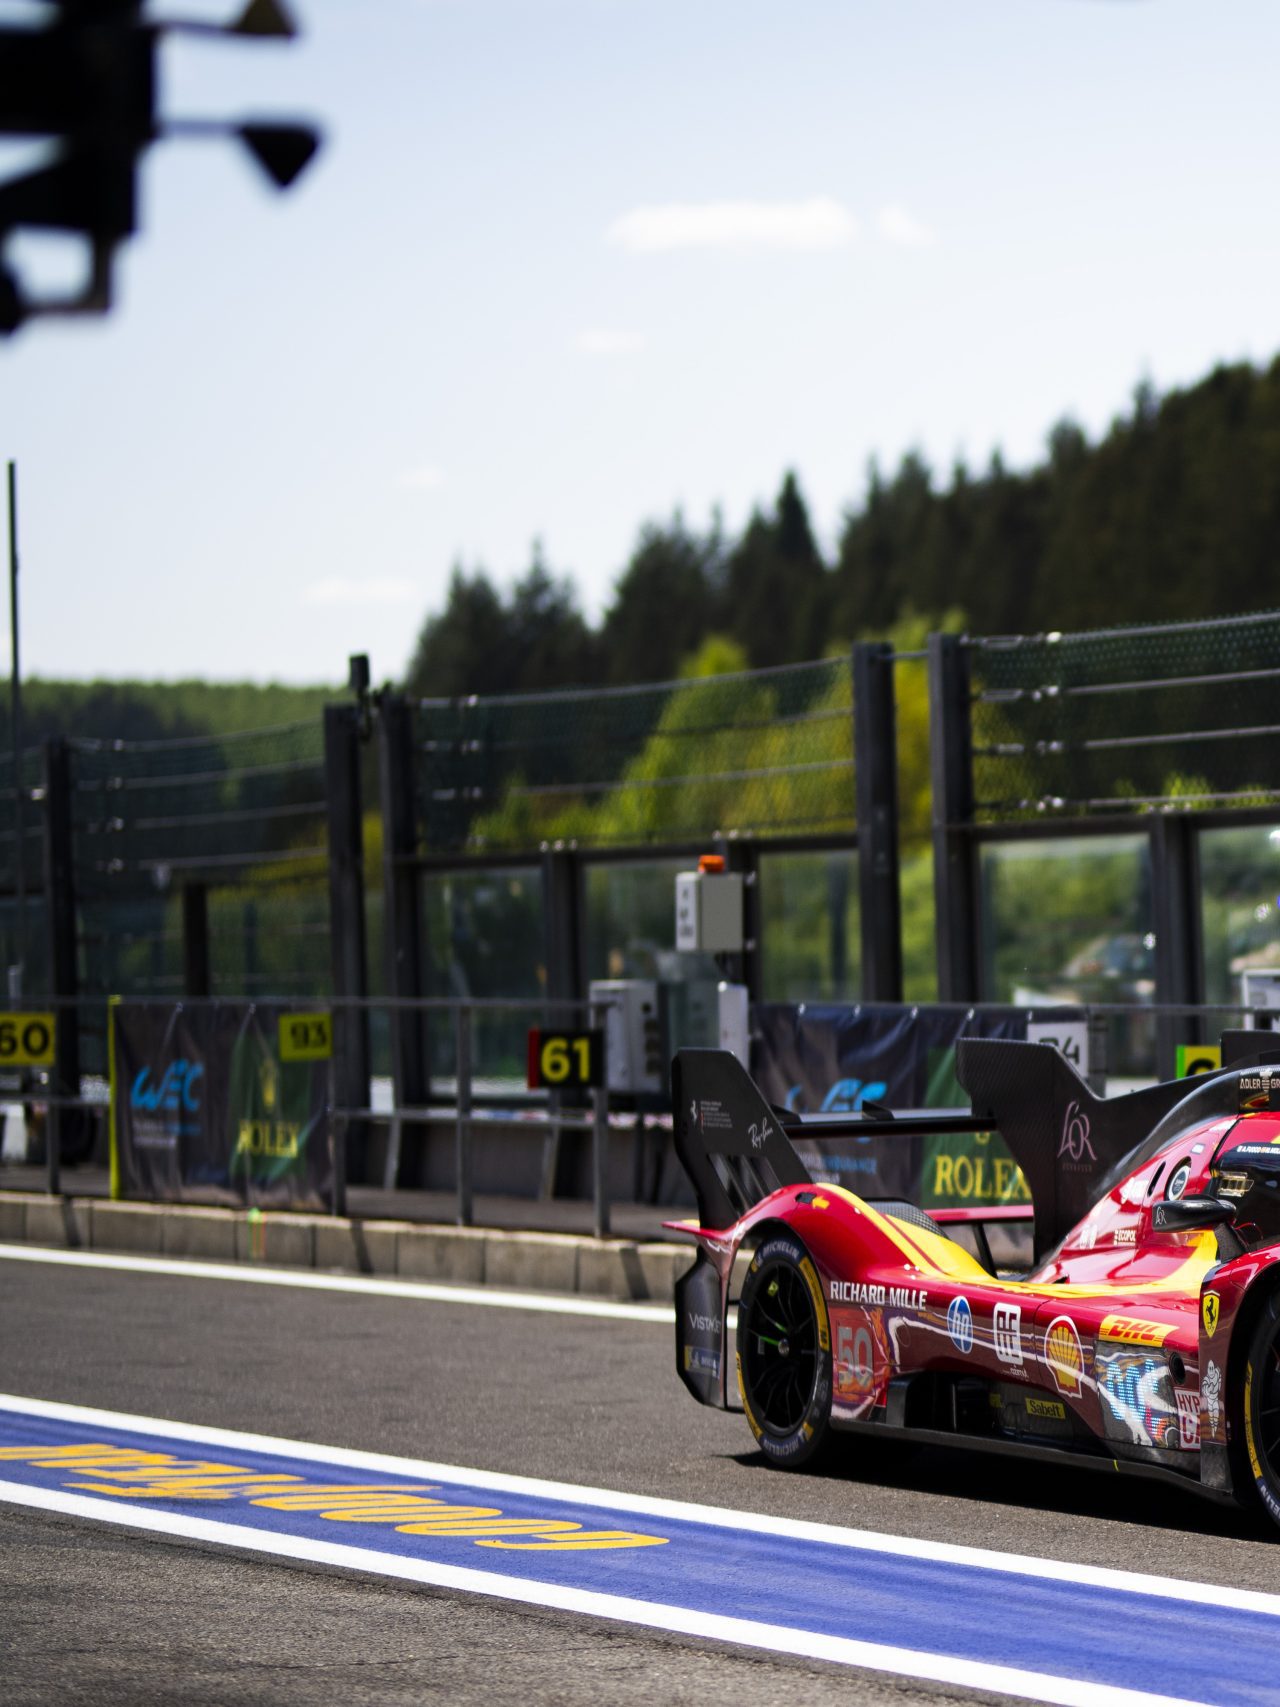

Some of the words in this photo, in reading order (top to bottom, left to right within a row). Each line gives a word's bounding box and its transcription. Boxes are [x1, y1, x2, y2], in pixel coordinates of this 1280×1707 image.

[541, 1037, 590, 1082] 61
[1239, 1078, 1261, 1089] ADLER
[934, 1155, 1032, 1199] ROLEX
[762, 1240, 800, 1259] MICHELIN
[830, 1280, 886, 1305] RICHARD
[889, 1287, 928, 1311] MILLE
[1108, 1319, 1157, 1341] DHL
[837, 1325, 874, 1389] 50
[1030, 1400, 1061, 1416] Sabelt
